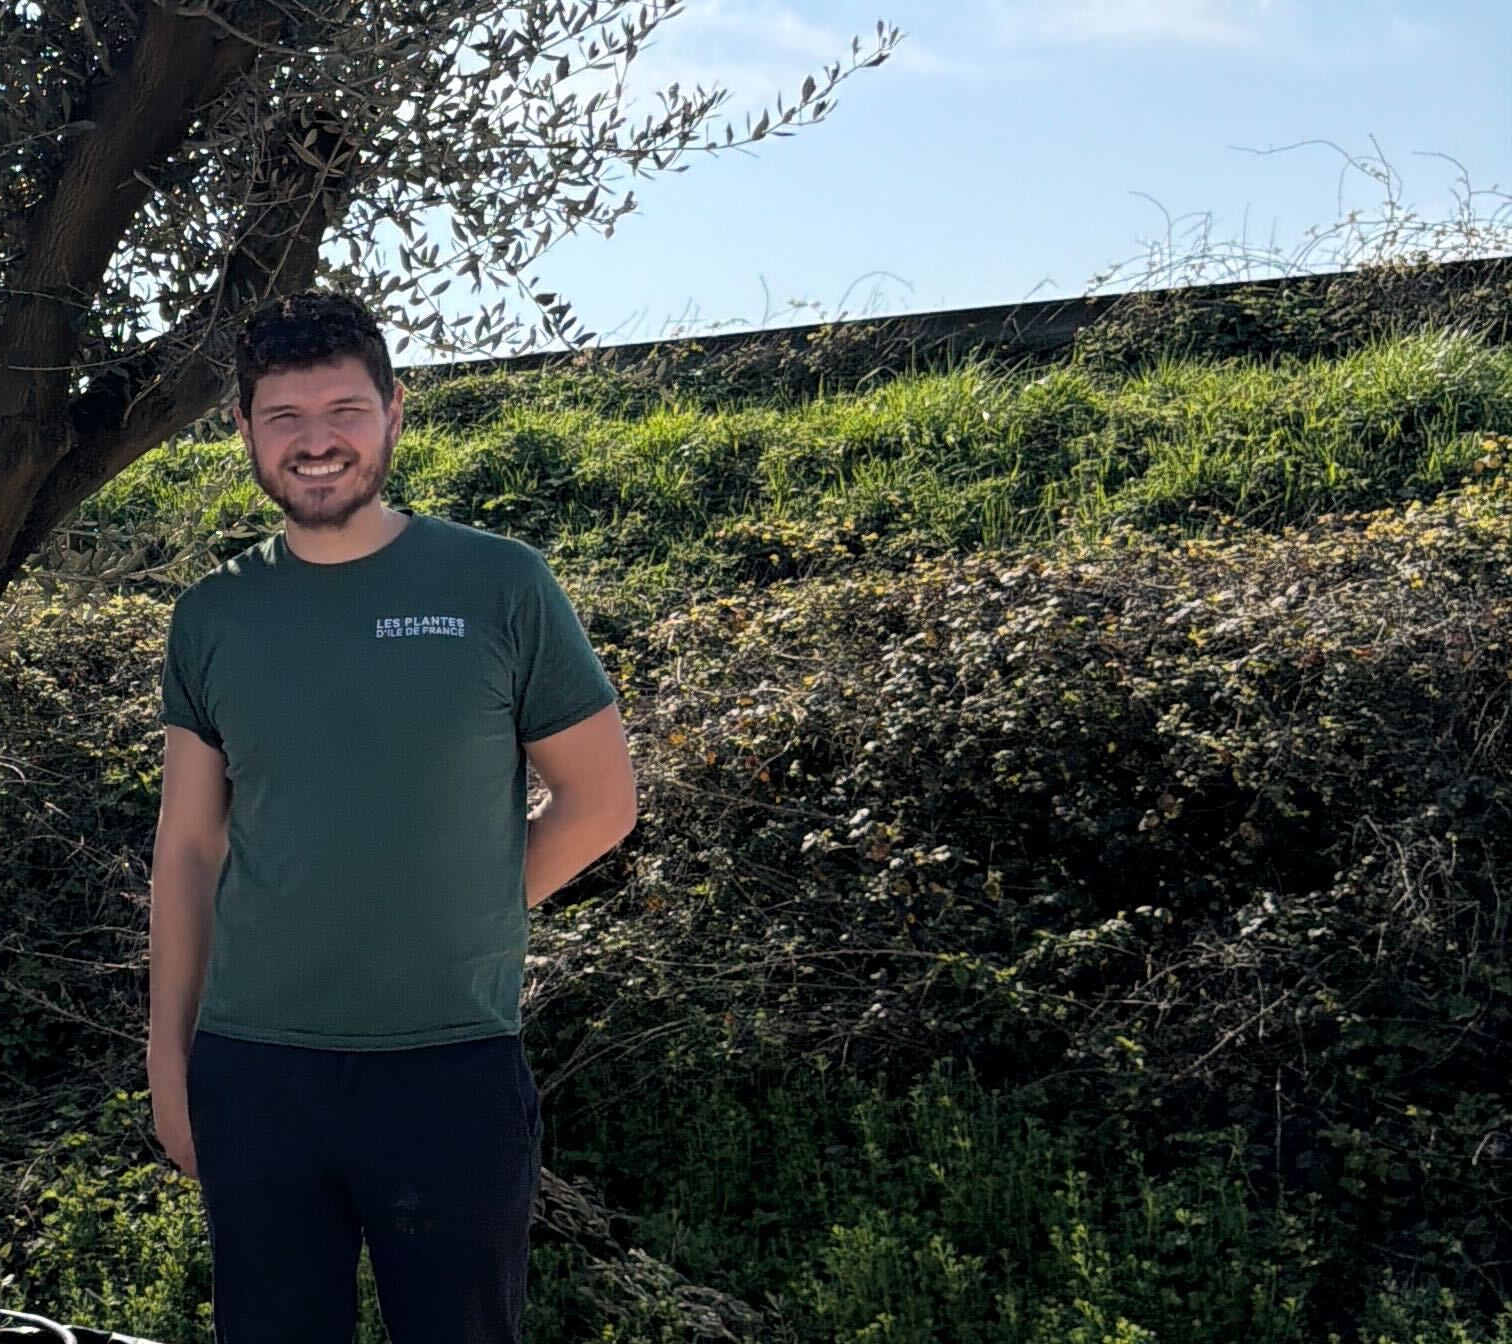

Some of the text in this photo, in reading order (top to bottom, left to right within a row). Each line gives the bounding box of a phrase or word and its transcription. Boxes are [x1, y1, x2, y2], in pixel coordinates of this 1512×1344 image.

[376, 616, 465, 628] LES PLANTES
[405, 627, 420, 636] DE
[422, 627, 465, 637] FRANCE
